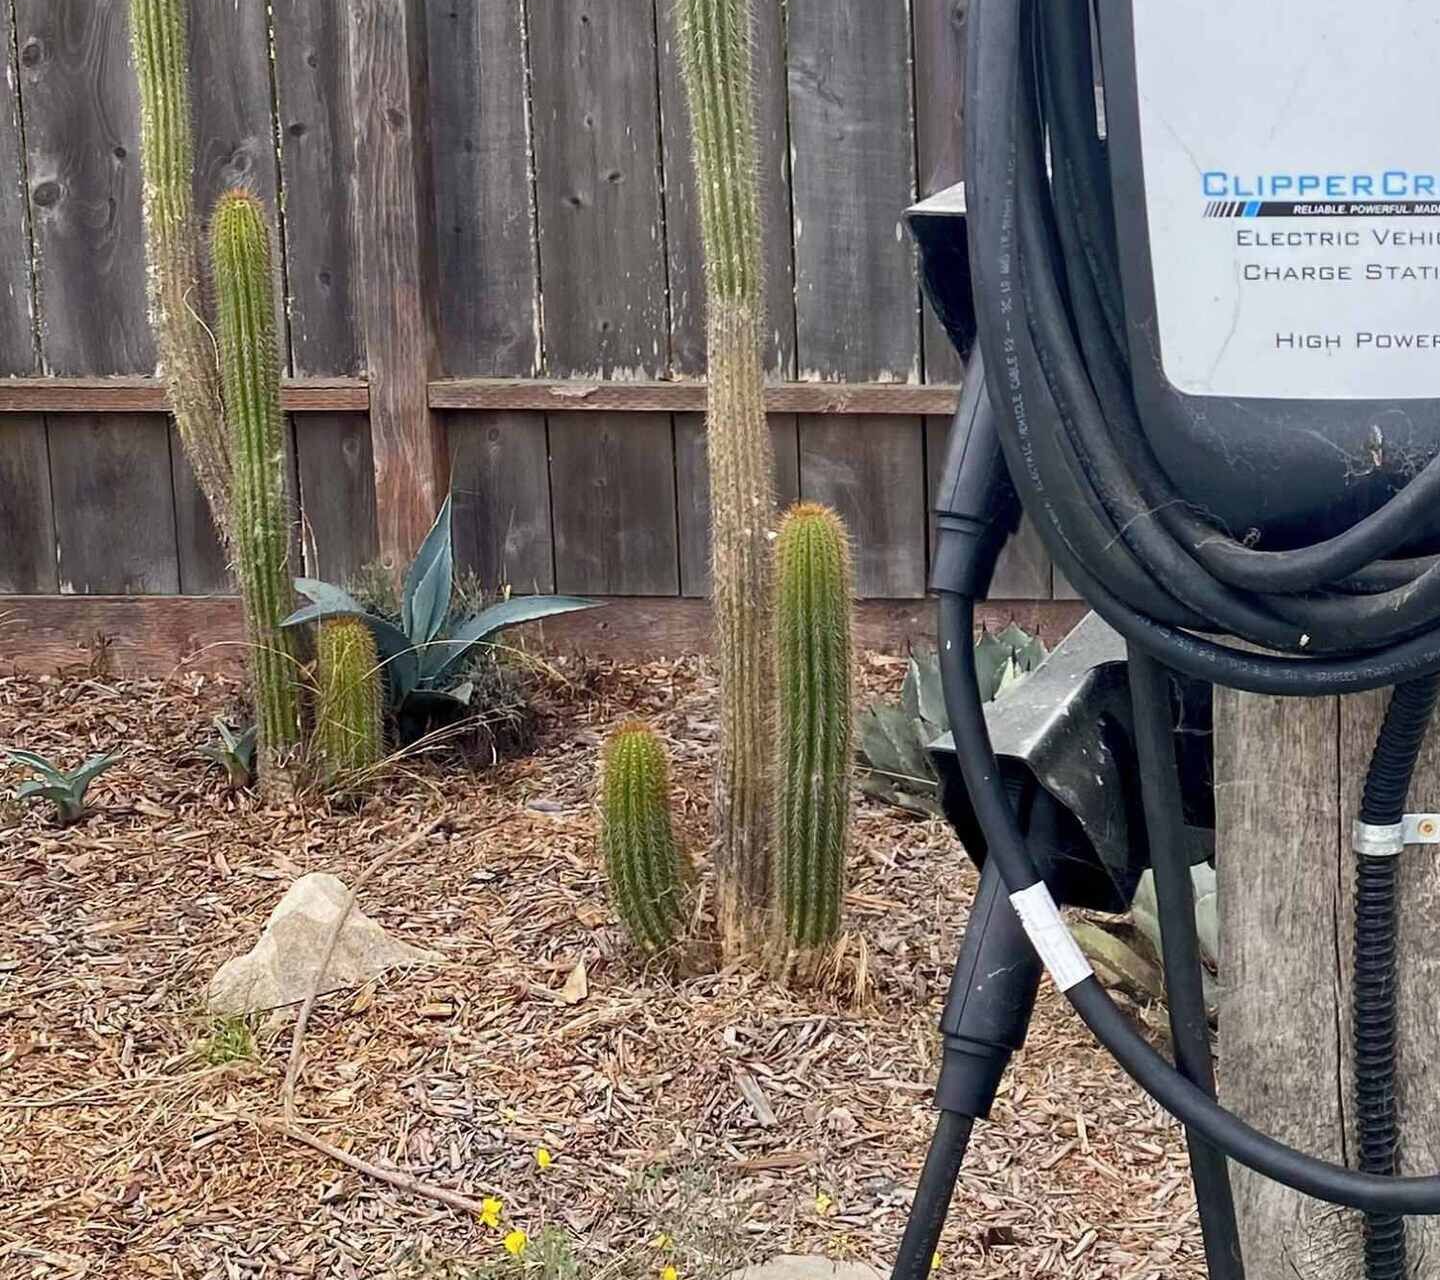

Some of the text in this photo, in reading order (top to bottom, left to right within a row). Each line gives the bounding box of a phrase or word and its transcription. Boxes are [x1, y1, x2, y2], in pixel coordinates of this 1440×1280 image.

[1293, 204, 1348, 215] RELIABLE.
[1350, 204, 1412, 215] POWERFUL.
[1236, 229, 1360, 247] ELECTRIC
[1243, 263, 1353, 281] CHARGE
[1275, 332, 1342, 349] HIGH
